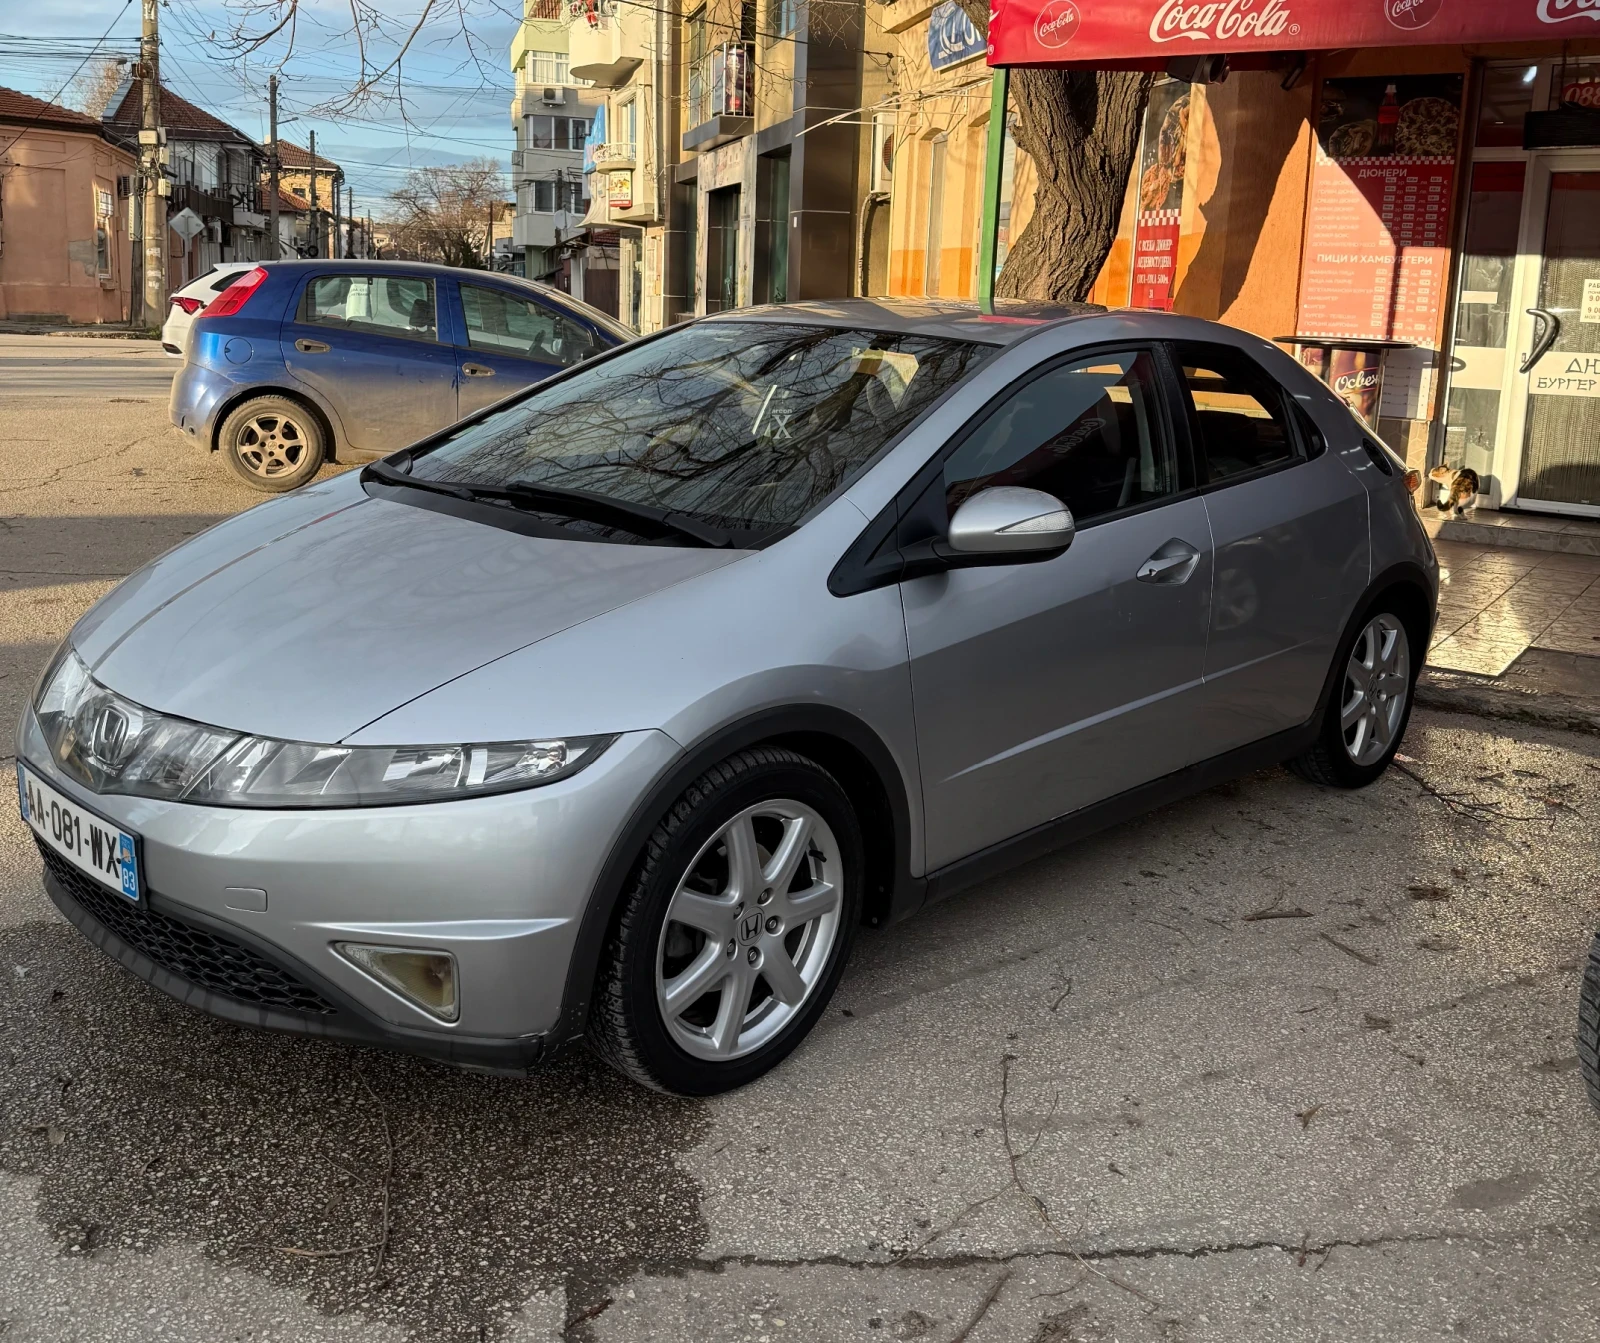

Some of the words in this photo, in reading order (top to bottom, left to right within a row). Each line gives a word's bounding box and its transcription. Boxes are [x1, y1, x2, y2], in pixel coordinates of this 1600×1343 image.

[1040, 7, 1075, 37] Coca-Cola
[1149, 0, 1291, 43] Coca-Cola
[1357, 168, 1407, 178] ДЮНЕРИ
[1317, 254, 1348, 264] ПИЦИ
[1350, 254, 1358, 263] И
[1360, 254, 1433, 265] ХАМБУРГЕРИ
[1537, 377, 1597, 391] БУРГЕР
[27, 779, 120, 879] AA-081-WX
[122, 867, 136, 892] 83
